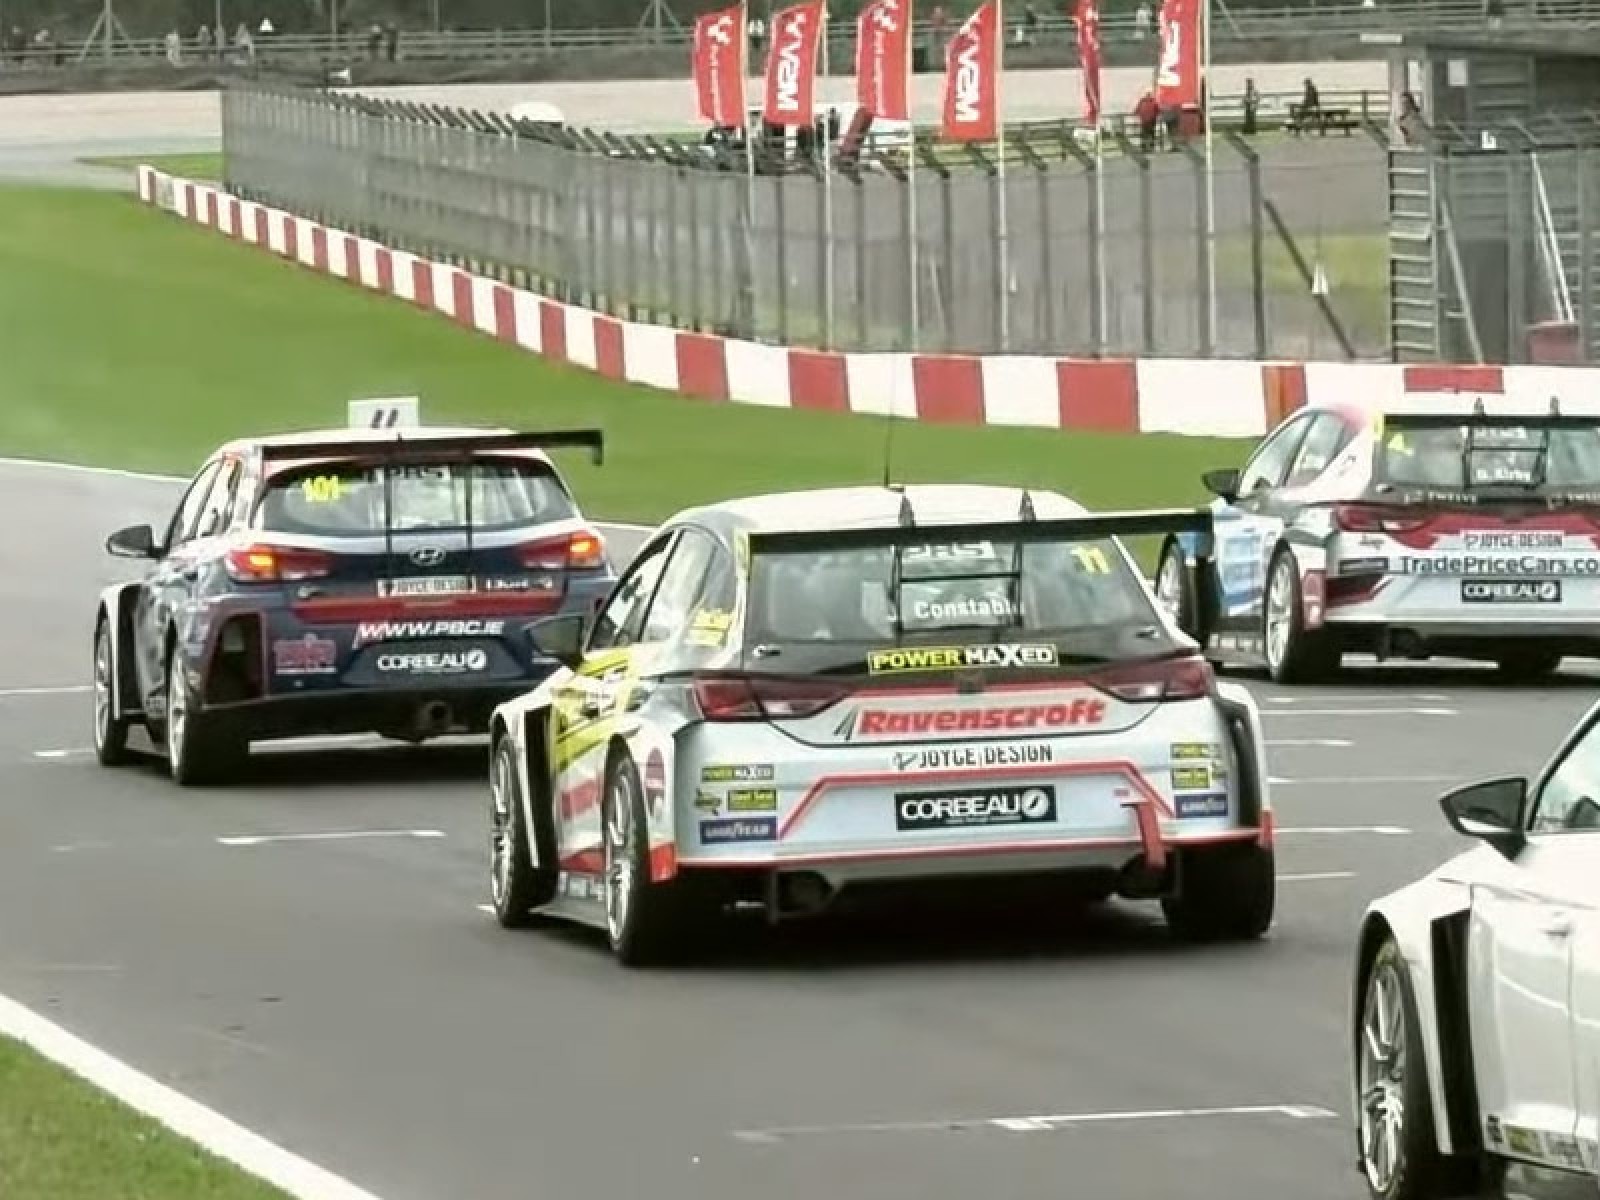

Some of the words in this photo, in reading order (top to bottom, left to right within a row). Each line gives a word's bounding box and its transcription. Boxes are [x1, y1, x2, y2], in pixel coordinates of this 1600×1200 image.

[1069, 545, 1110, 575] 11
[376, 653, 466, 671] CORBEAU
[872, 648, 961, 670] POWER
[965, 643, 1053, 667] MAXED
[859, 698, 1106, 735] Ravenscroft
[918, 747, 977, 769] JOYCE
[984, 743, 1053, 765] DESIGN
[901, 792, 1020, 821] CORBEAU
